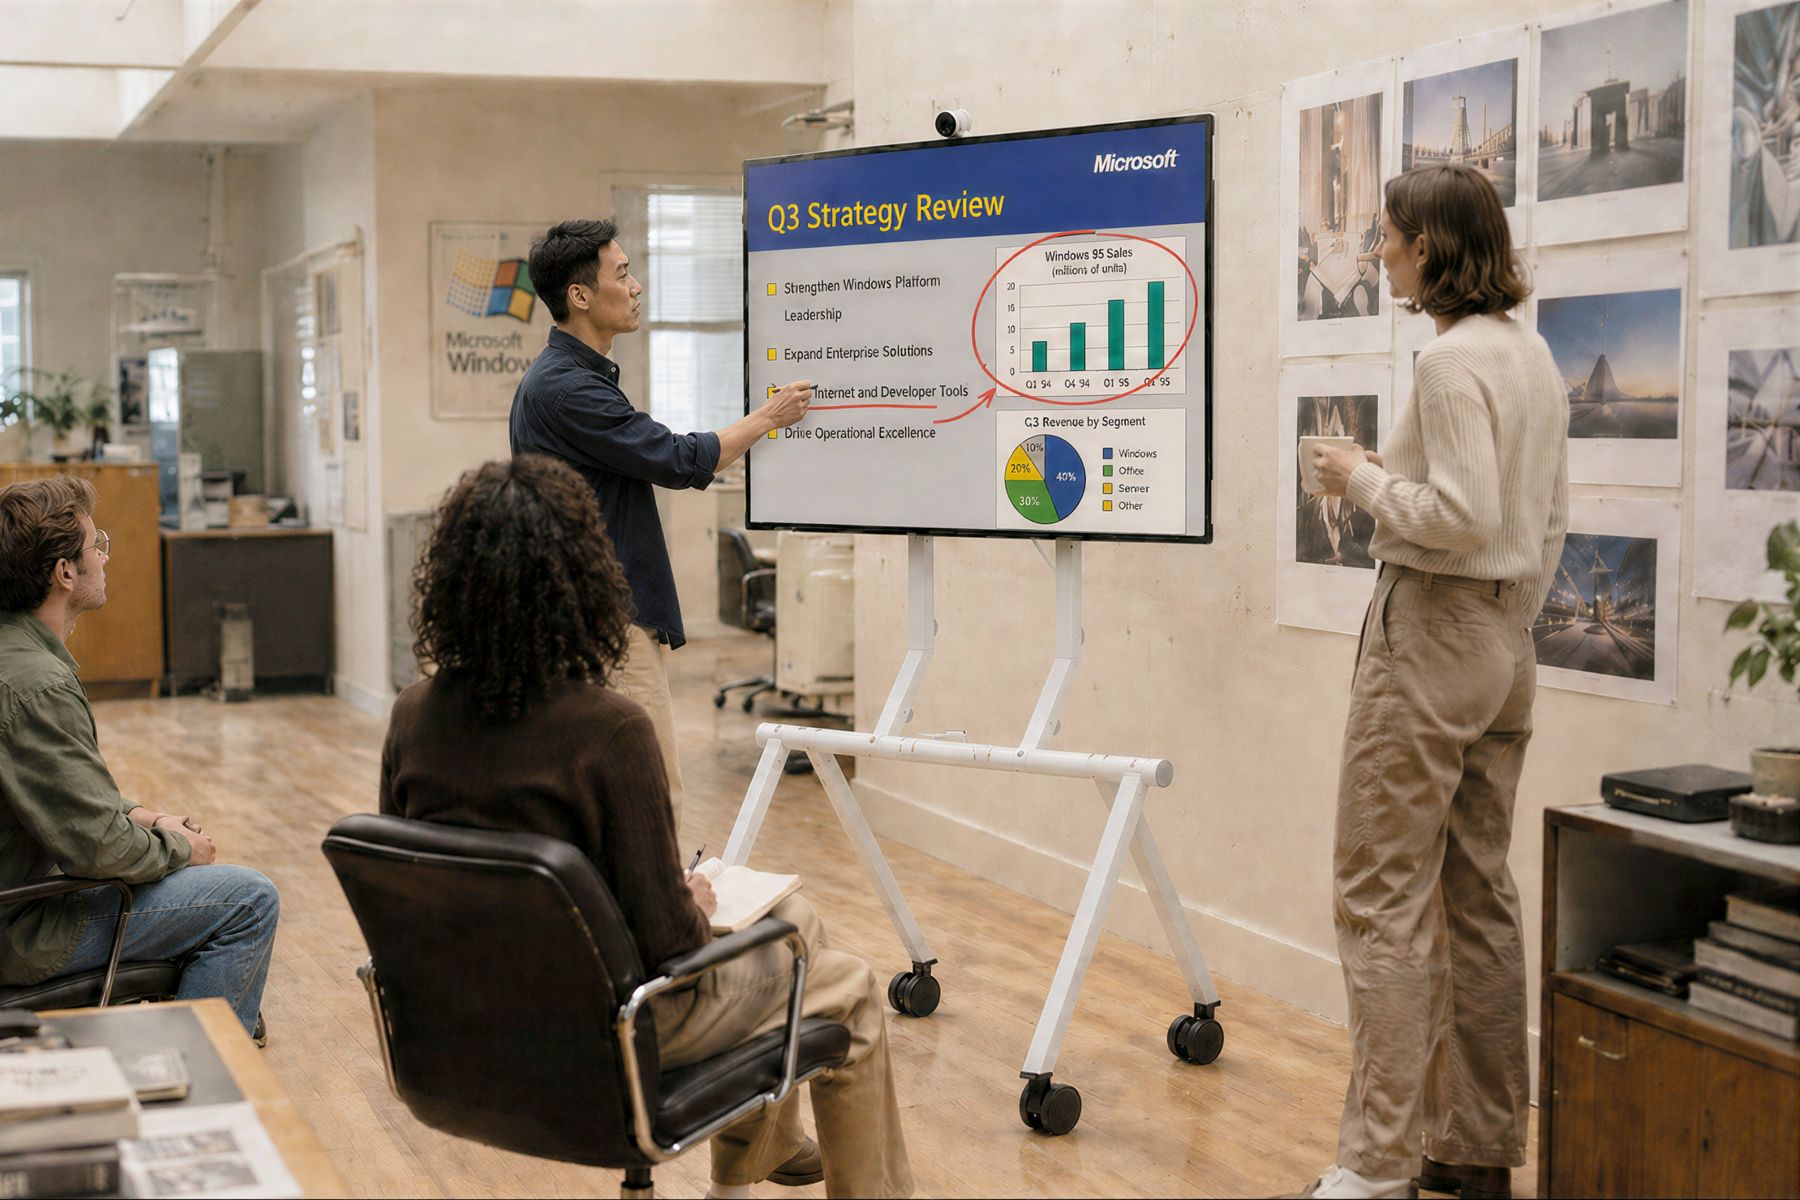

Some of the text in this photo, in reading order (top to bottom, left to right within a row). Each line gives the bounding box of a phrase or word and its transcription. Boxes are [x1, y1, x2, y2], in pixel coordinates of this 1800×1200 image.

[1093, 148, 1180, 173] Microsoft
[767, 190, 1005, 235] Q3 Strategy Review
[1045, 247, 1133, 262] Windows 95 Sales
[1090, 264, 1100, 274] of
[784, 275, 941, 296] Strengthen Windows Platform
[1007, 282, 1016, 290] 20
[784, 307, 842, 322] Leadership
[1007, 325, 1016, 333] 10
[447, 331, 523, 349] Microsoft
[784, 344, 933, 363] Expand Enterprise Solutions
[1009, 346, 1015, 354] 5
[448, 353, 534, 374] Window
[1040, 379, 1051, 389] 94
[1078, 378, 1090, 388] 94
[1159, 377, 1171, 387] 95
[814, 385, 969, 400] Internet and Developer Tools
[1087, 416, 1099, 430] by
[1102, 416, 1146, 430] Segment
[815, 426, 876, 442] Operational
[879, 426, 936, 439] Excellence
[1026, 443, 1044, 453] 10%
[1119, 448, 1158, 460] Windows
[1010, 463, 1032, 474] 20%
[1055, 471, 1077, 482] 40%
[1019, 496, 1040, 507] 30%
[1118, 501, 1144, 512] Other
